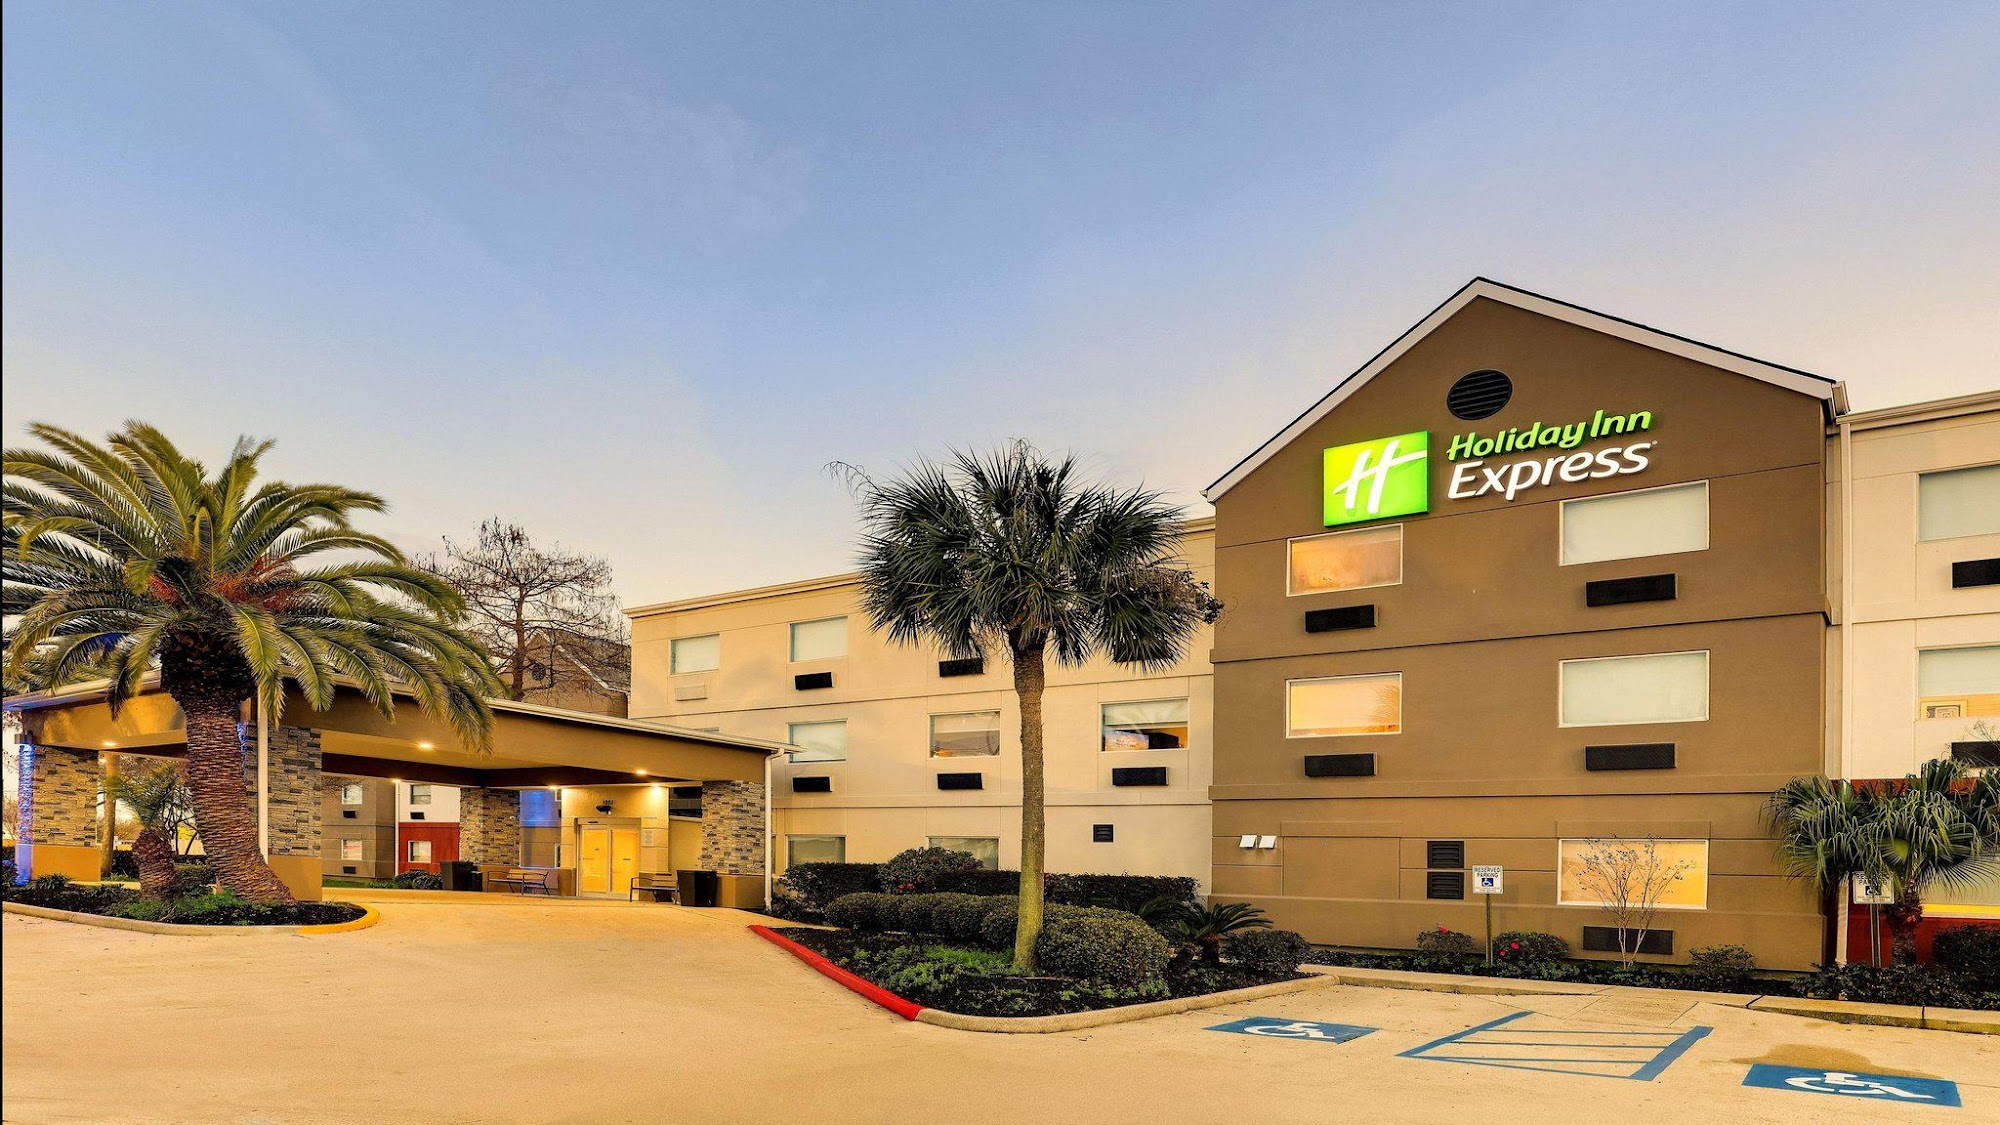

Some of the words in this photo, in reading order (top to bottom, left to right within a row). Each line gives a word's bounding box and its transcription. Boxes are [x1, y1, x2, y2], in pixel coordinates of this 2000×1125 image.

[1446, 421, 1587, 461] Holiday
[1590, 409, 1653, 438] Inn
[1447, 442, 1653, 501] Express
